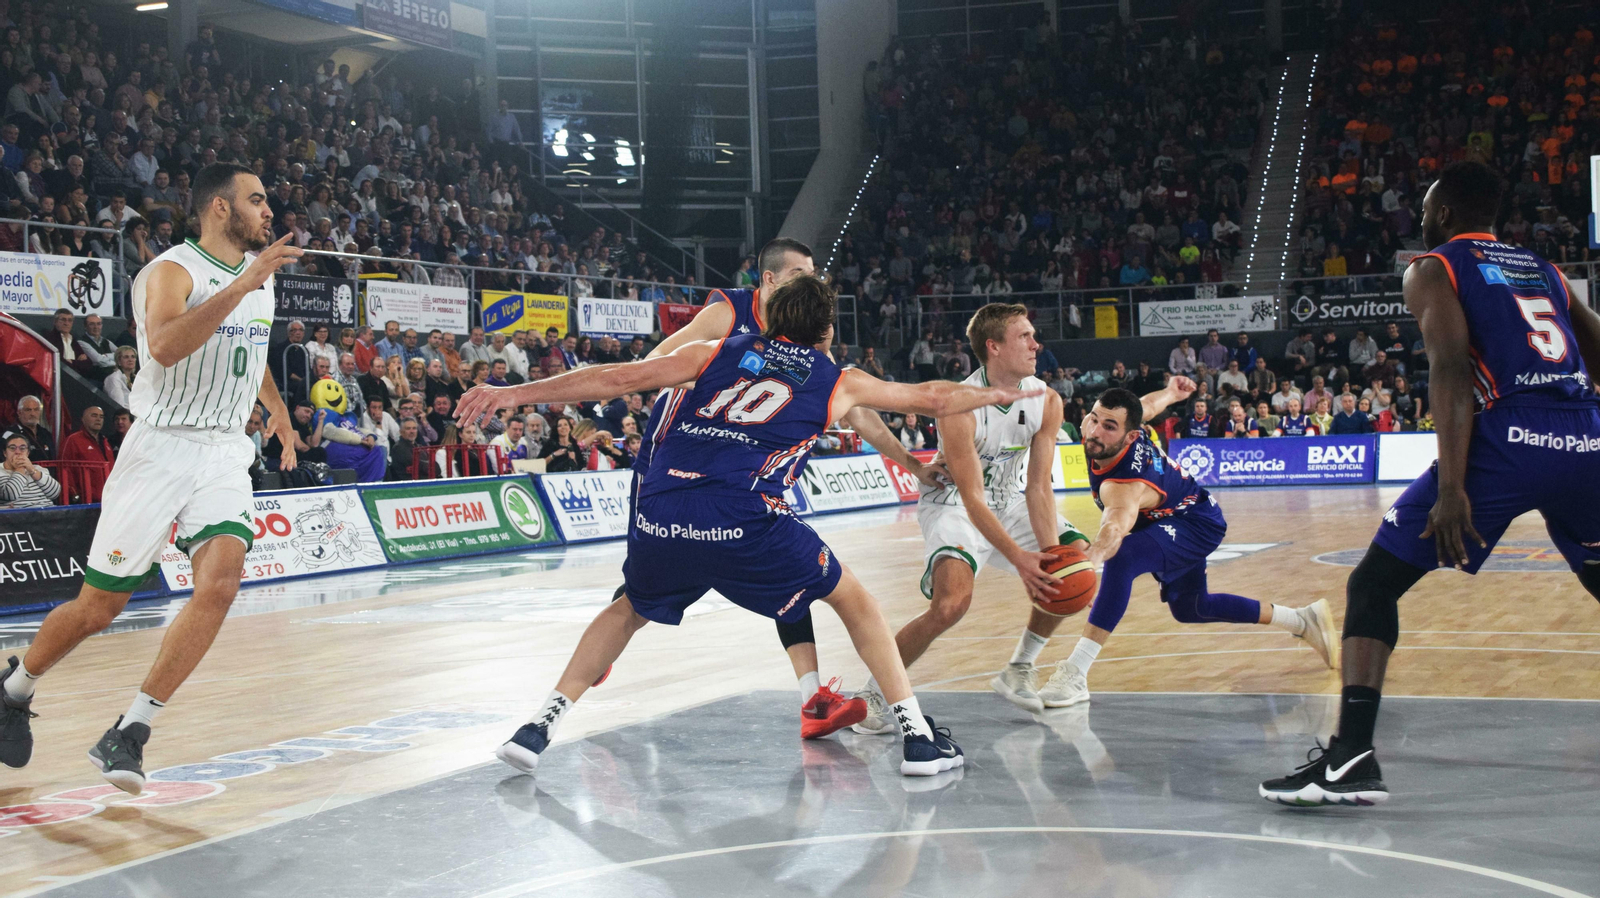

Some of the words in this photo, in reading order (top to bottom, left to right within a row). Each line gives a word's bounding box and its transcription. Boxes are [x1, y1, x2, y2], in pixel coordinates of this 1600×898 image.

[42, 259, 66, 267] deportiva
[1483, 249, 1534, 261] Ayuntamiento
[1498, 256, 1539, 268] Palencia
[1502, 269, 1540, 279] Diputación
[283, 279, 326, 291] RESTAURANTE
[2, 290, 33, 305] Mayor
[293, 294, 331, 312] Martina
[501, 299, 521, 319] Vega
[249, 326, 269, 339] plus
[605, 318, 639, 332] DENTAL
[1513, 294, 1567, 363] 5
[231, 345, 248, 378] 0
[695, 377, 793, 425] 10
[1507, 426, 1564, 450] Diario
[1220, 448, 1265, 461] tecno
[1307, 444, 1366, 464] BAXI
[1218, 458, 1286, 474] palencia
[1307, 463, 1337, 471] SERVICIO
[1337, 463, 1364, 471] OFICIAL
[816, 462, 889, 494] lambda
[598, 496, 625, 517] REY
[394, 504, 439, 531] AUTO
[443, 501, 487, 525] FFAM
[575, 527, 601, 538] PALENCIA
[636, 513, 669, 539] Diario
[670, 523, 744, 542] Palentino
[277, 541, 289, 550] 147
[253, 562, 285, 578] 370
